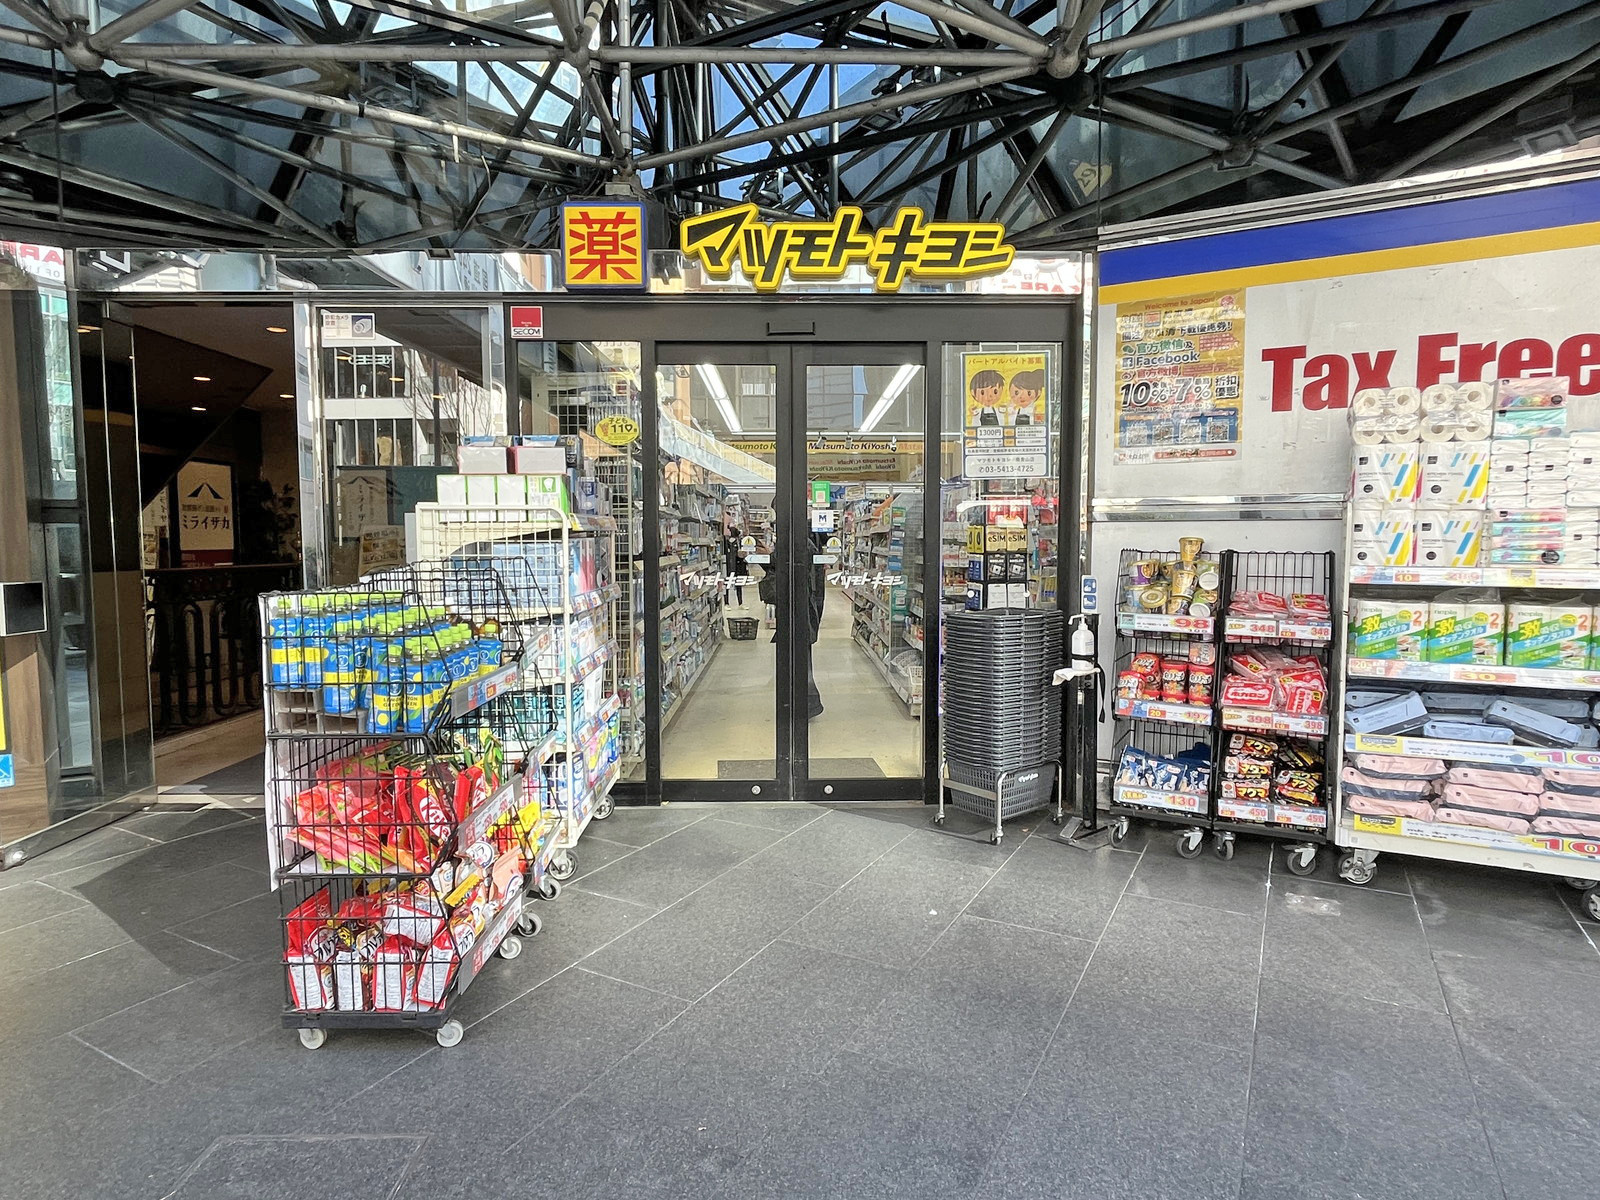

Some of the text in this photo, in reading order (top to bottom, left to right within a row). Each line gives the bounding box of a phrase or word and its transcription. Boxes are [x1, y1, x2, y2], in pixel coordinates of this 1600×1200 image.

[569, 211, 637, 281] 薬
[685, 207, 1011, 284] マツモトキヨシ
[1145, 301, 1179, 311] Welcome
[513, 328, 541, 336] SECOM
[1137, 352, 1199, 366] Facebook
[1261, 332, 1600, 413] Tax Free
[980, 429, 1001, 437] 1300円
[680, 572, 757, 589] マツモトキヨシ
[827, 572, 904, 589] マツモトキヨシ
[1174, 618, 1210, 629] 98
[1249, 624, 1275, 633] 348
[1311, 627, 1330, 636] 348
[1185, 711, 1208, 720] 197
[1247, 715, 1271, 723] 398
[1170, 795, 1196, 806] 130
